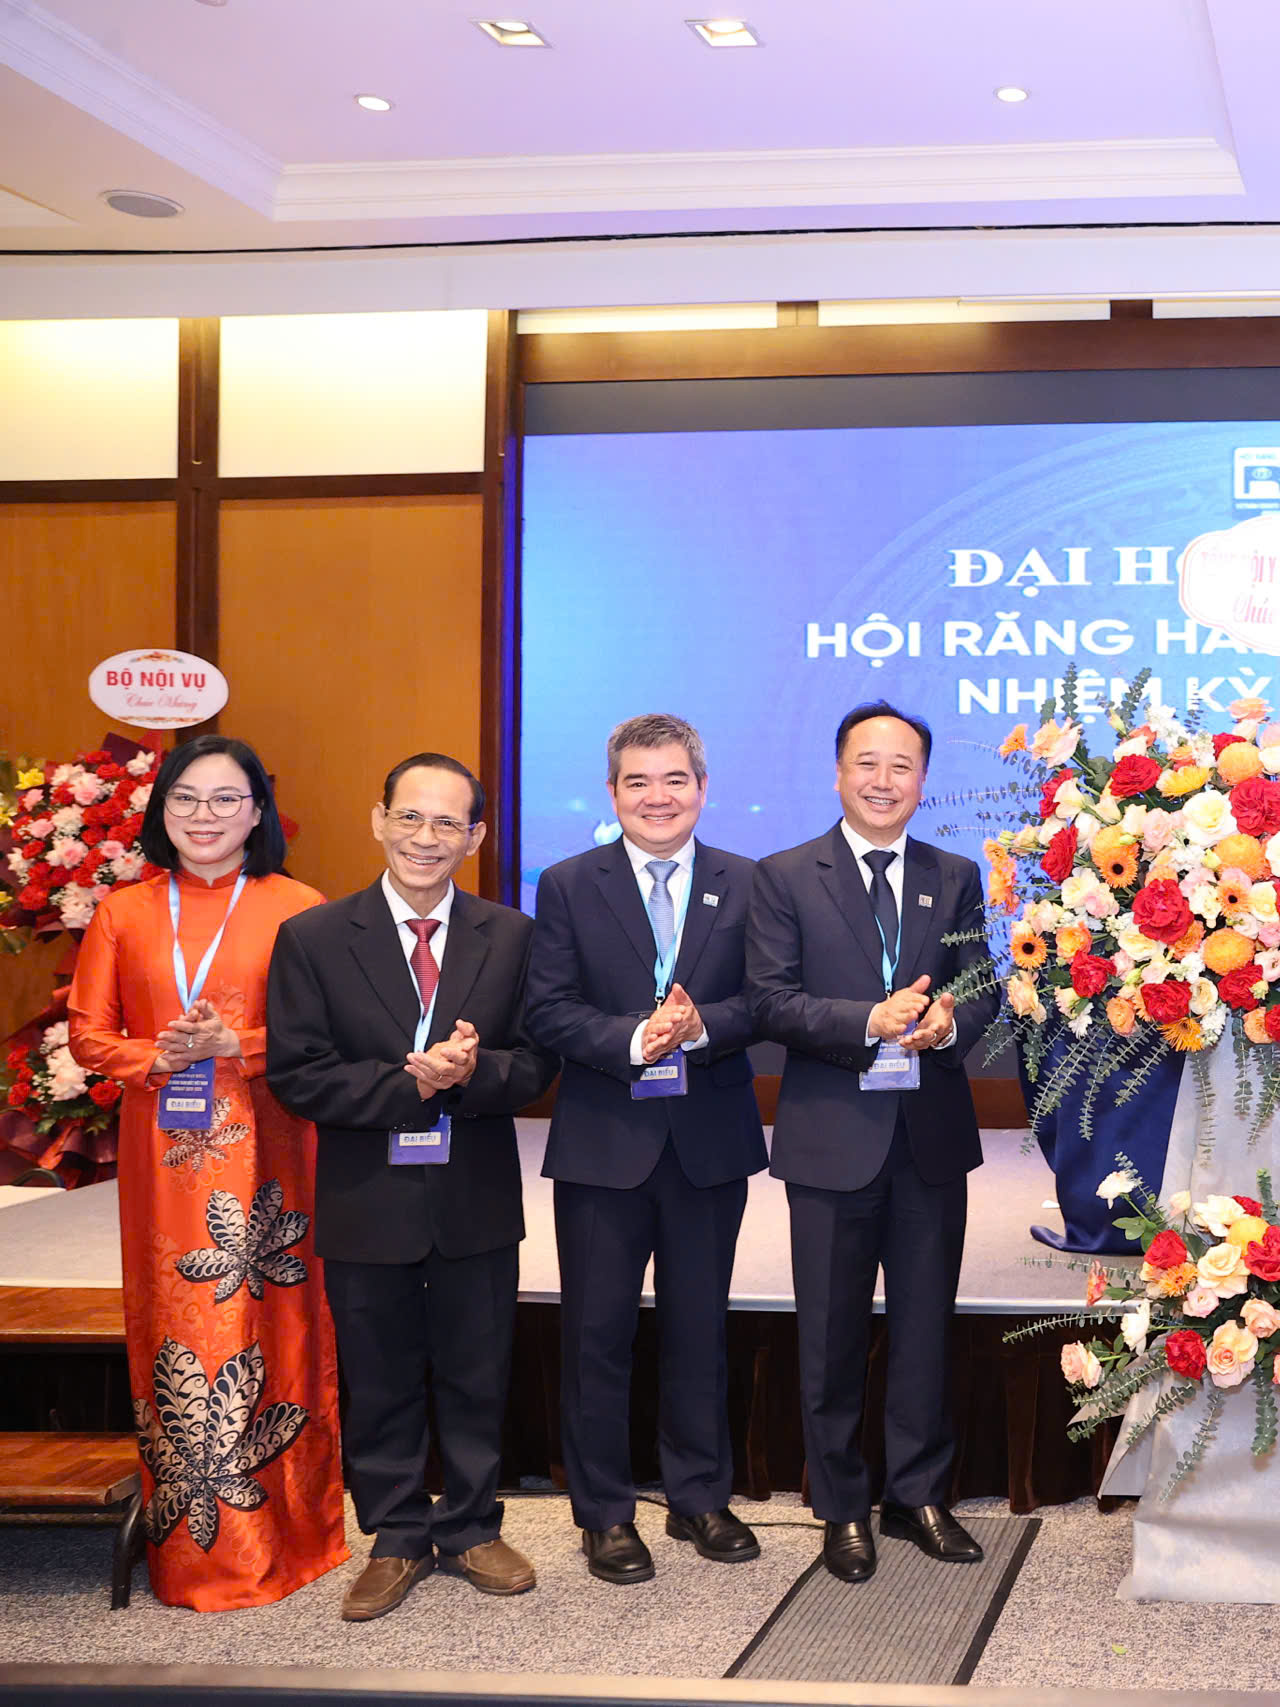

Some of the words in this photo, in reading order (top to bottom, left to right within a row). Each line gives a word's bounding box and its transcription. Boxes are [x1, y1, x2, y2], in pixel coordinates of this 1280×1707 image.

[948, 547, 1092, 597] ĐẠI
[807, 612, 921, 668] HỘI
[944, 611, 1135, 656] RĂNG
[106, 668, 133, 690] BỘ
[140, 669, 174, 691] NỘI
[181, 672, 206, 692] VỤ
[1187, 667, 1272, 713] KỲ
